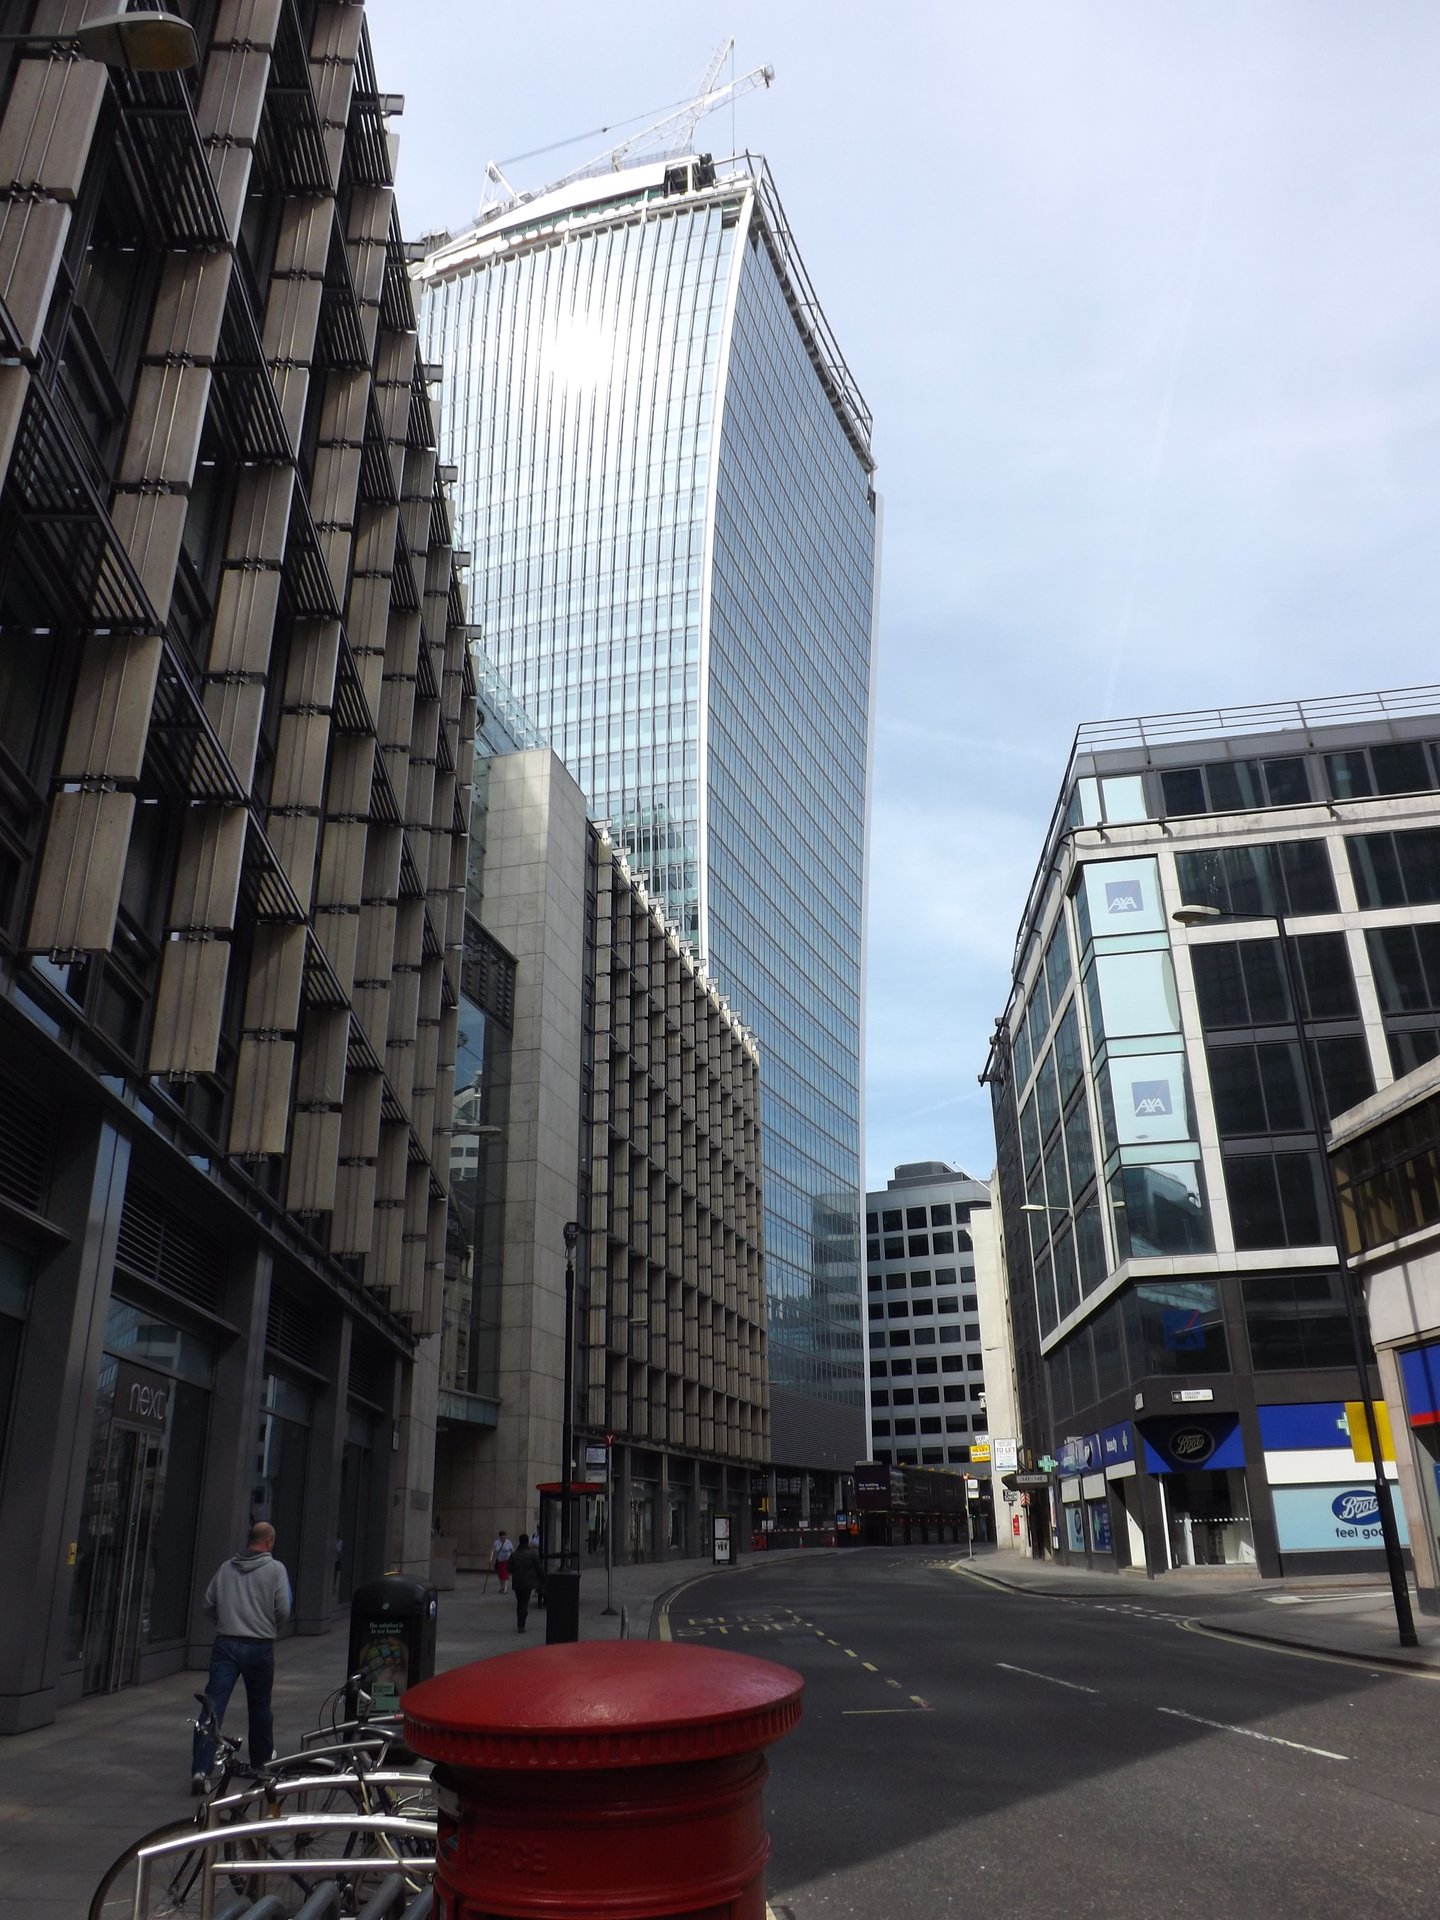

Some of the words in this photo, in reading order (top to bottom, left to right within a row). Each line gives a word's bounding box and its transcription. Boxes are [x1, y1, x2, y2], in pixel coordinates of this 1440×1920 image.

[1108, 896, 1138, 911] AXA
[1135, 1098, 1166, 1113] AXA
[129, 1383, 166, 1420] next
[606, 1434, 613, 1444] Y
[1176, 1434, 1205, 1455] Boots
[1335, 1527, 1359, 1538] feel
[1362, 1528, 1385, 1540] goo
